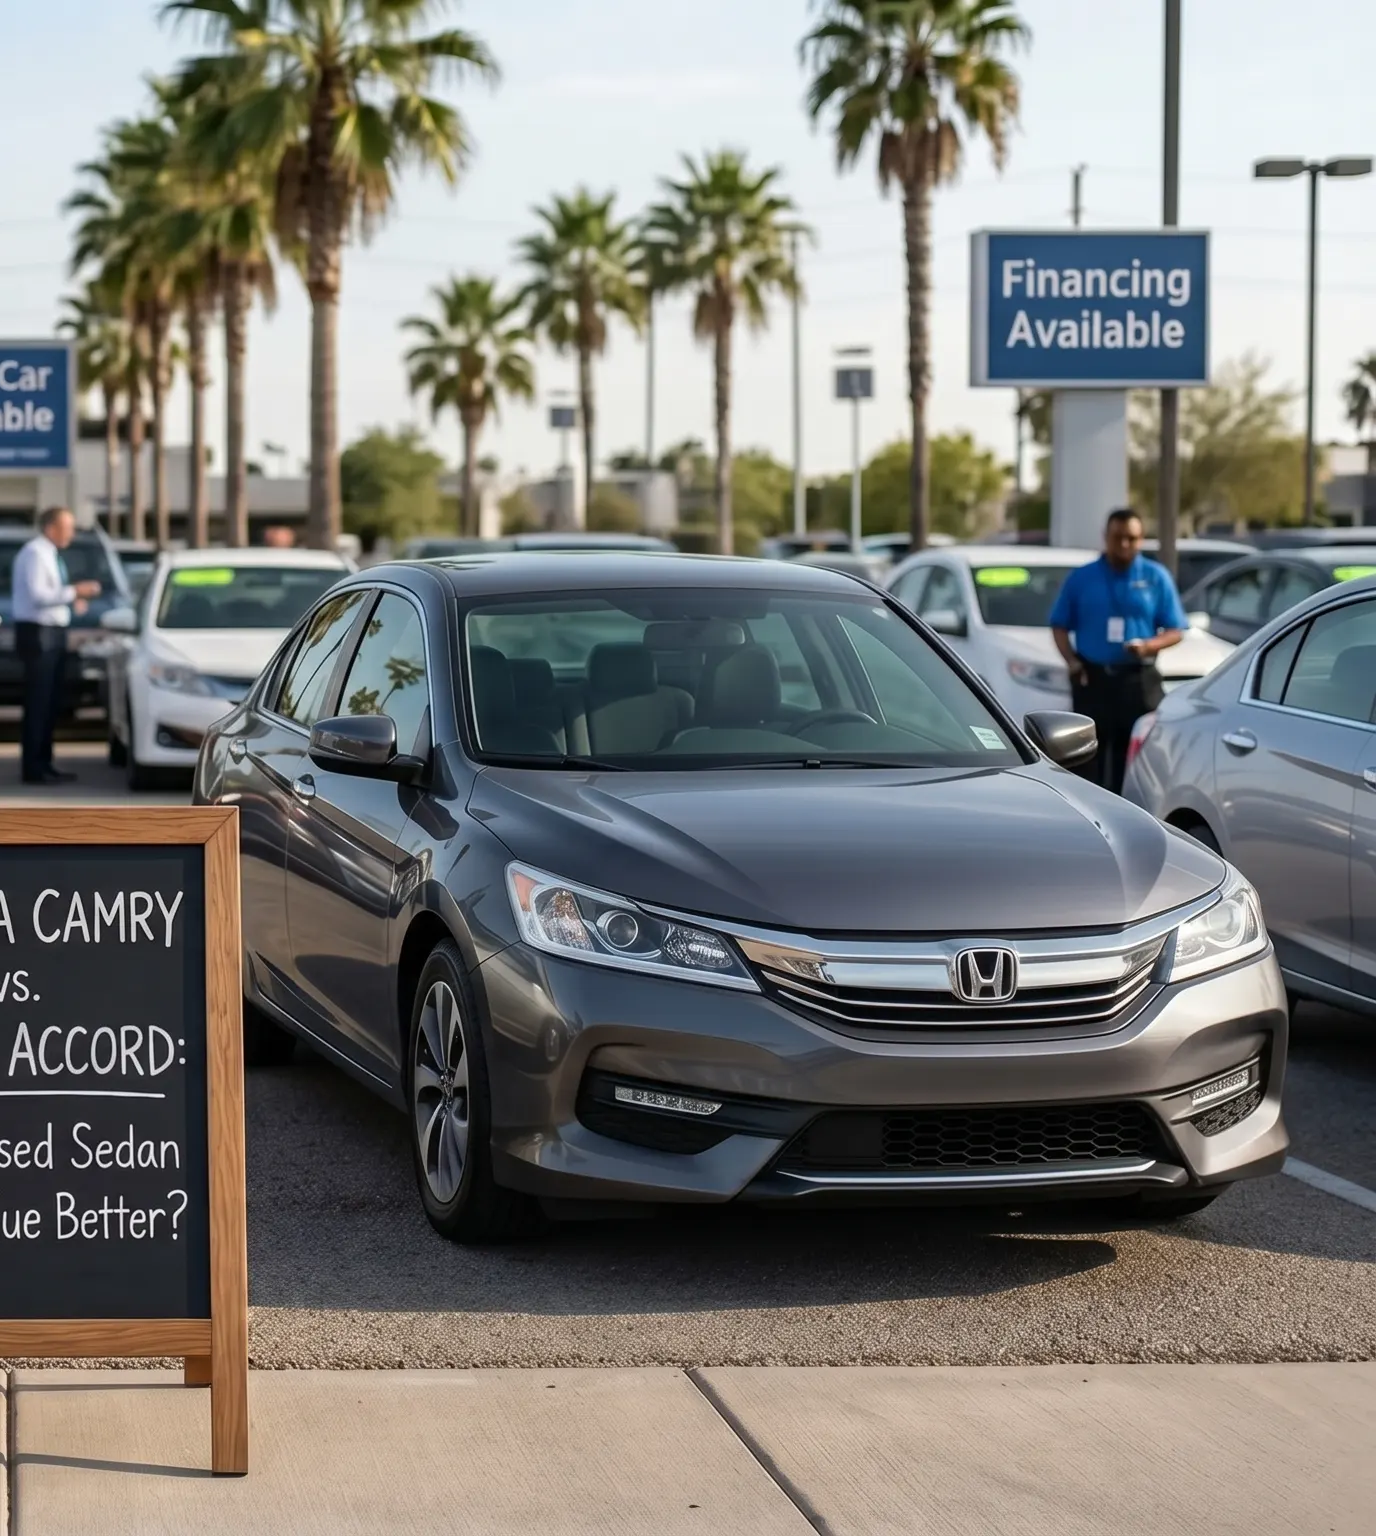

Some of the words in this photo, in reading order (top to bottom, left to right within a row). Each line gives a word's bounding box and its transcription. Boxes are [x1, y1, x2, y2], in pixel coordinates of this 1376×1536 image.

[1002, 257, 1191, 307] Financing
[1006, 309, 1185, 349] Available
[33, 888, 184, 947] CAMRY
[8, 1021, 187, 1077] ACCORD:
[70, 1122, 180, 1169] Sedan
[56, 1189, 188, 1241] Better?
